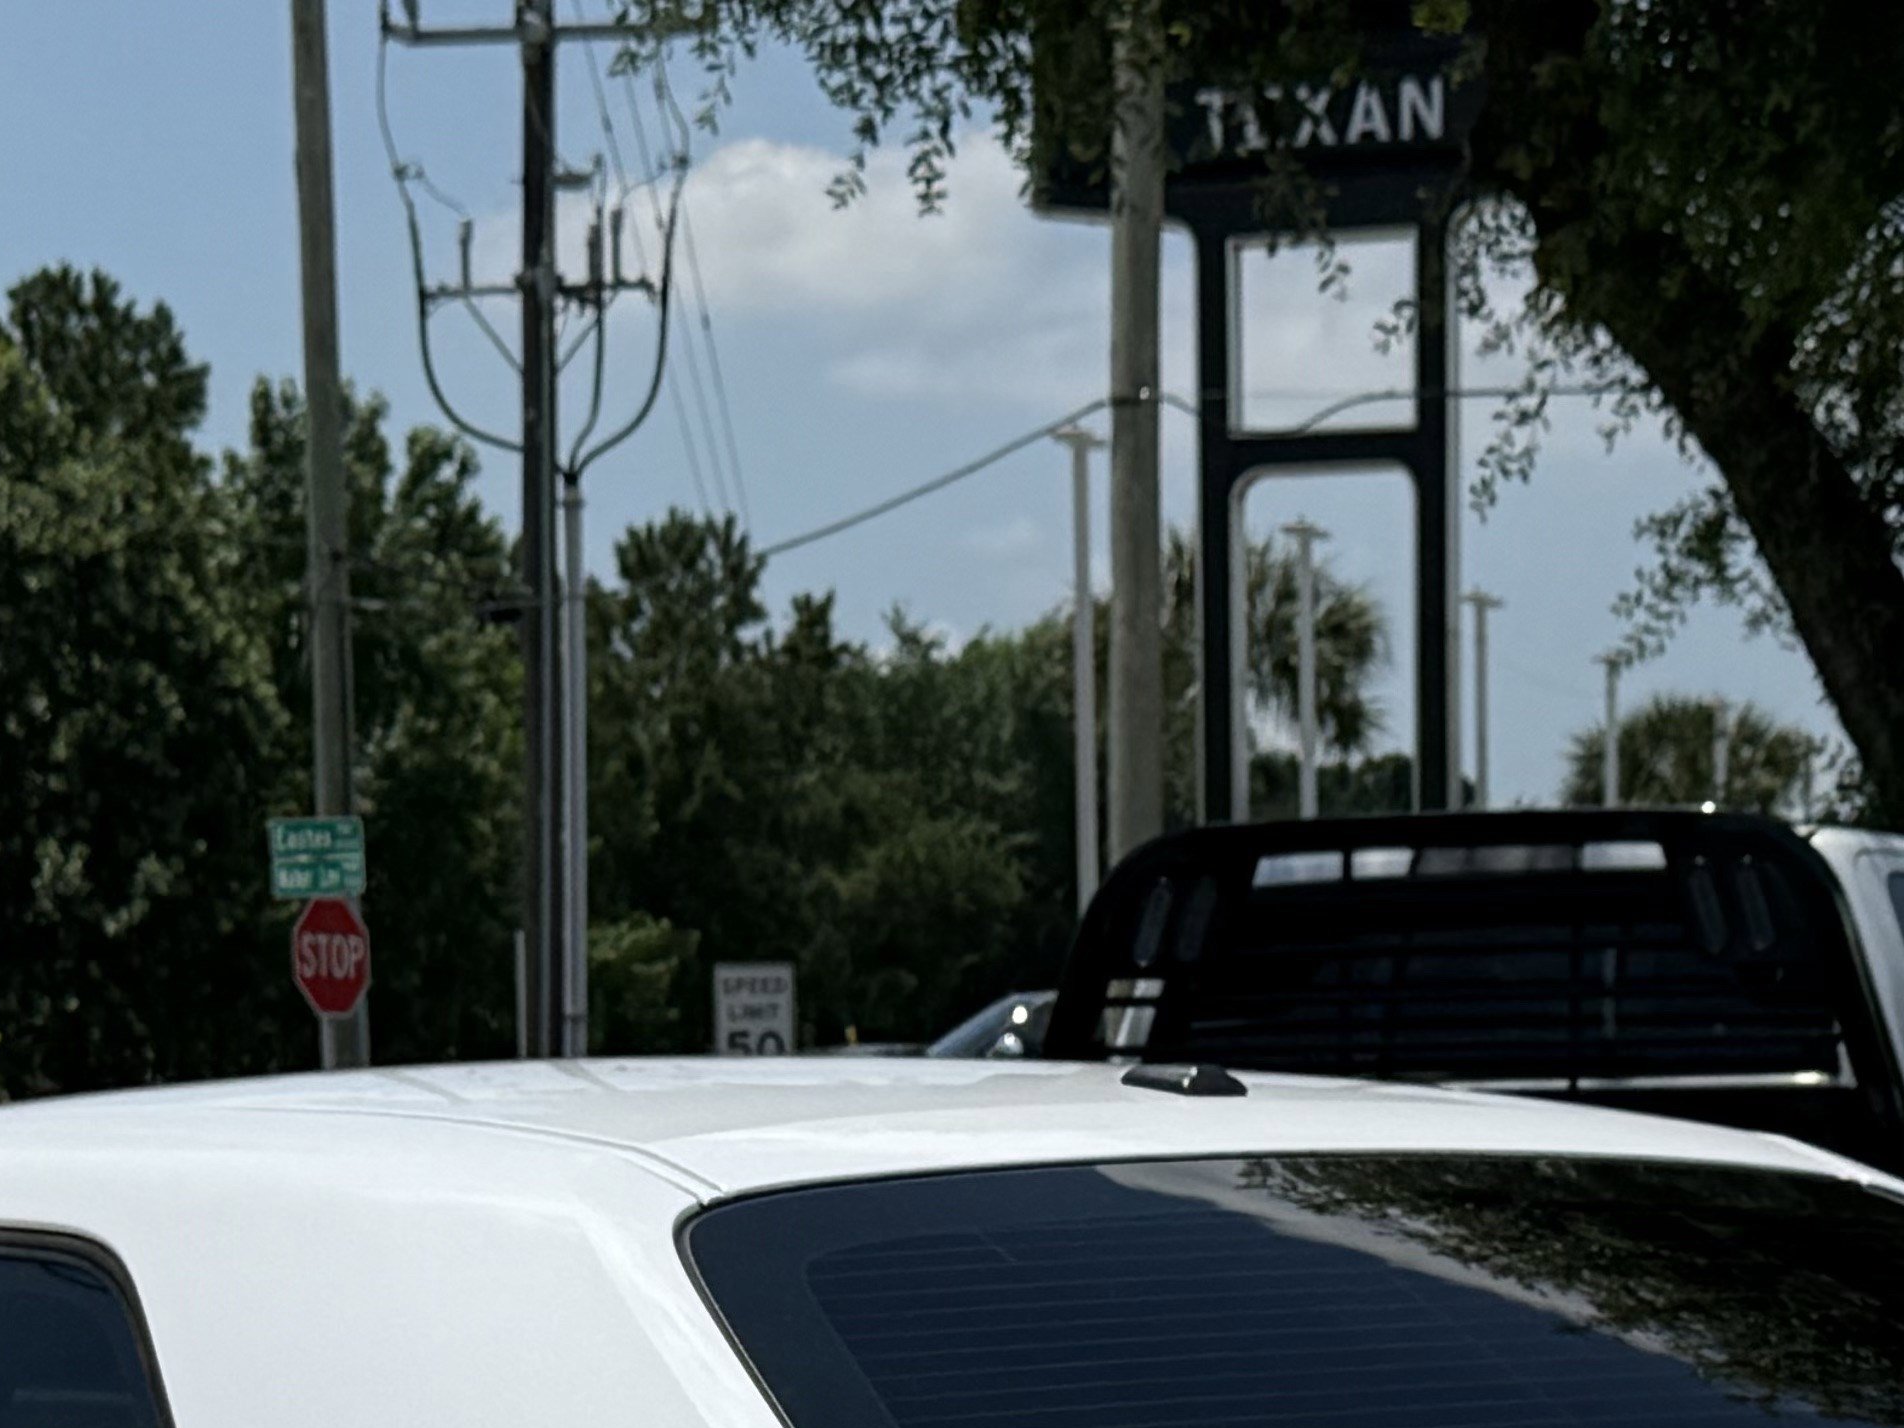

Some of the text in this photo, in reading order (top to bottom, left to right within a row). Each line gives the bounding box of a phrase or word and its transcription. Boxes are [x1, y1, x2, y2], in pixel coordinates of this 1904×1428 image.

[298, 932, 365, 979] STOP
[722, 977, 788, 995] SPEED
[725, 1002, 780, 1022] LIMIT
[727, 1029, 786, 1057] 50
